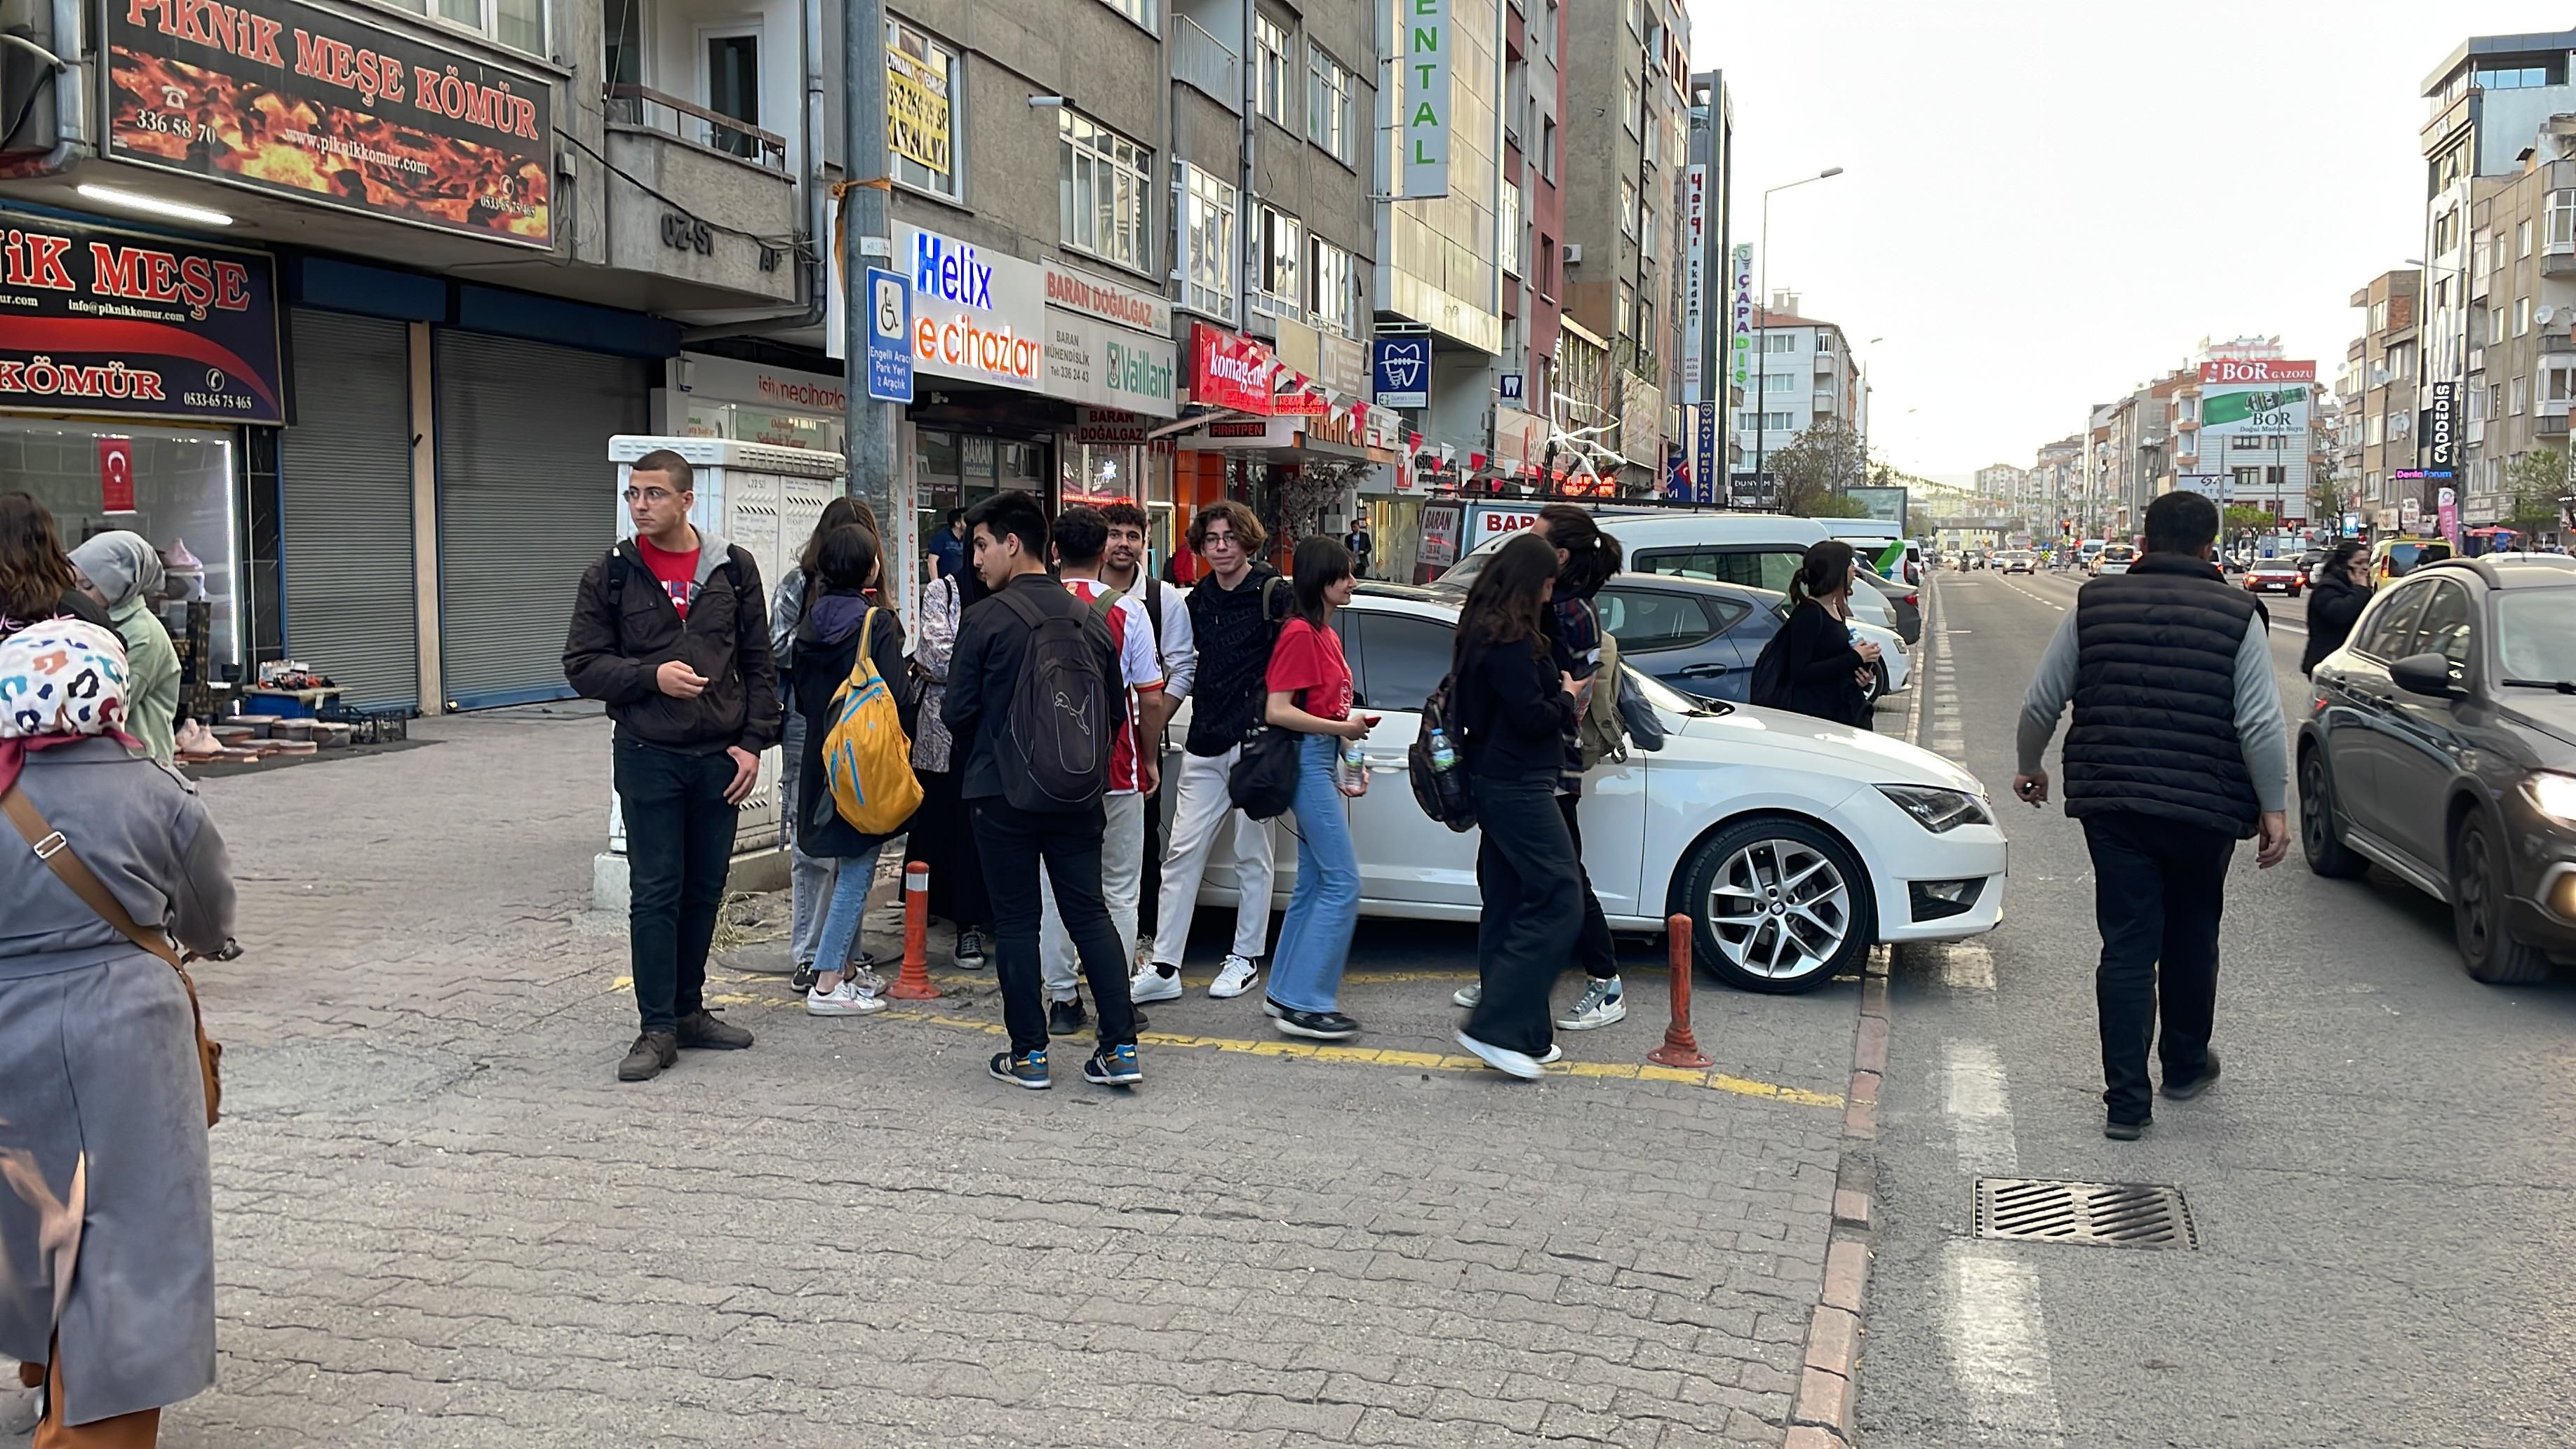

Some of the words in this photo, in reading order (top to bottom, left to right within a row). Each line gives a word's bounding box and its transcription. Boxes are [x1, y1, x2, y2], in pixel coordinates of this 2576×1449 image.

[294, 28, 405, 107] MEŞE
[414, 65, 539, 140] KÖMÜR
[136, 109, 168, 133] 336
[173, 117, 192, 140] 58
[197, 123, 217, 145] 70
[284, 127, 429, 176] www.piknikkomur.com
[90, 241, 250, 321] MEŞE
[913, 232, 993, 311] Helix
[1047, 271, 1090, 309] BARAN
[1093, 285, 1152, 328] DOĞALGAZ
[68, 298, 186, 323] info@piknikkomur.com
[1056, 330, 1079, 347] BARAN
[870, 345, 893, 362] Engelli
[1045, 344, 1090, 367] MÜHENDİSLİK
[0, 355, 166, 400] KÖMÜR
[876, 360, 891, 375] Park
[892, 363, 906, 377] Yeri
[1061, 366, 1072, 379] 336
[1073, 368, 1080, 381] 24
[1082, 371, 1089, 384] 43
[1121, 345, 1172, 400] Vaillant
[2222, 363, 2269, 380] BOR
[2272, 370, 2314, 379] GAZOZU
[877, 376, 882, 387] 2
[184, 391, 220, 407] 0533-65
[222, 394, 234, 408] 75
[236, 395, 252, 410] 465
[1089, 410, 1134, 423] BARAN
[2253, 411, 2292, 426] BOR
[1081, 424, 1143, 441] DOĞALGAZ
[1212, 424, 1263, 436] FIRATPEN
[963, 437, 993, 464] BARAN
[1425, 510, 1453, 531] BARAN
